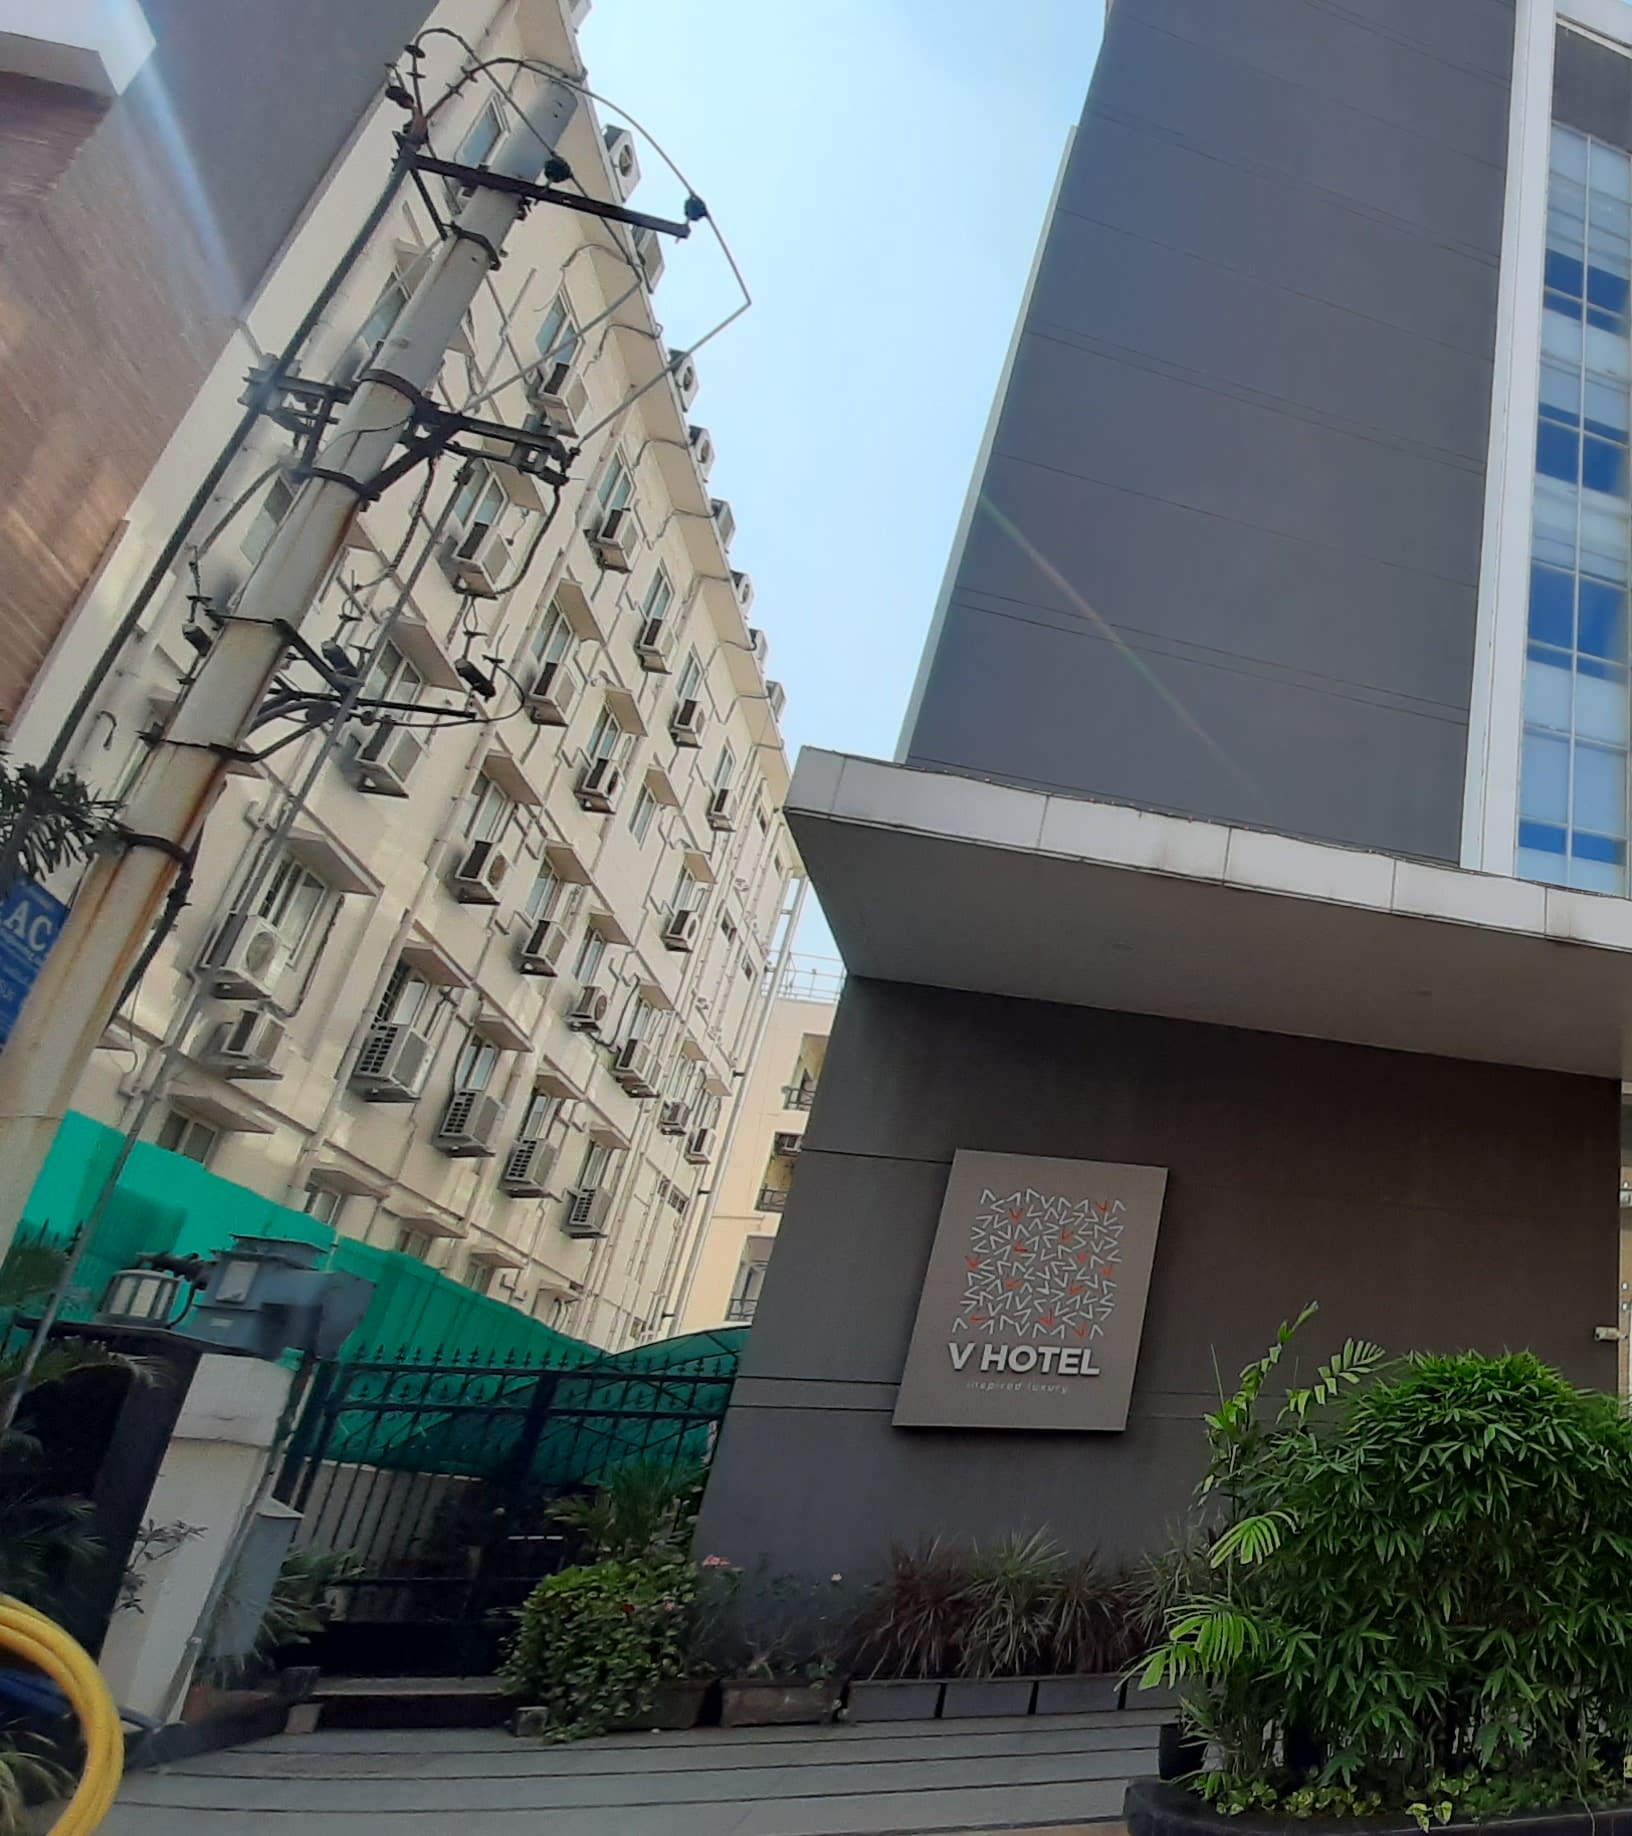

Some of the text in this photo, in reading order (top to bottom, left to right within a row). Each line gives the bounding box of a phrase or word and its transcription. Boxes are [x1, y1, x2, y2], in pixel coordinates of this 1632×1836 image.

[0, 899, 51, 952] AC
[949, 1342, 1101, 1377] V HOTEL
